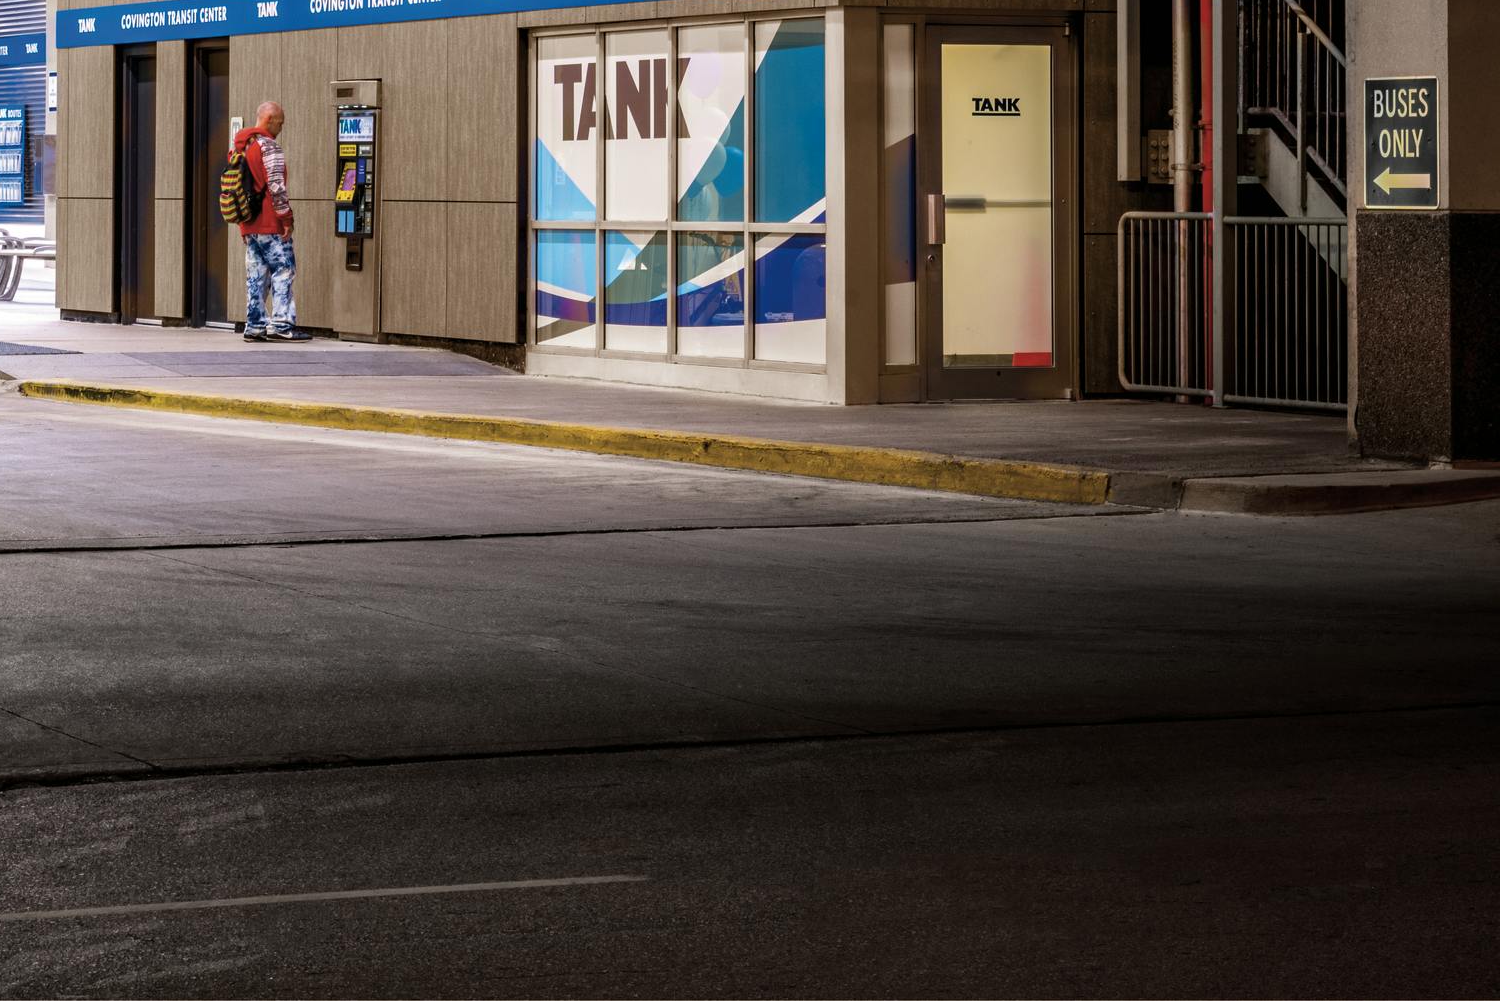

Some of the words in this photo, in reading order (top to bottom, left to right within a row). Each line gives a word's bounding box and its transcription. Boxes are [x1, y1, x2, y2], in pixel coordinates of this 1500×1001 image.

[121, 13, 165, 30] COVINGTON
[168, 8, 197, 26] TRANSIT
[199, 6, 227, 23] CENTER
[257, 2, 278, 18] TANK
[78, 18, 96, 33] TANK
[25, 43, 38, 54] TANK
[554, 58, 691, 141] TANK
[972, 98, 1020, 112] TANK
[1374, 88, 1428, 118] BUSES
[340, 119, 361, 134] TANK
[1379, 128, 1423, 158] ONLY
